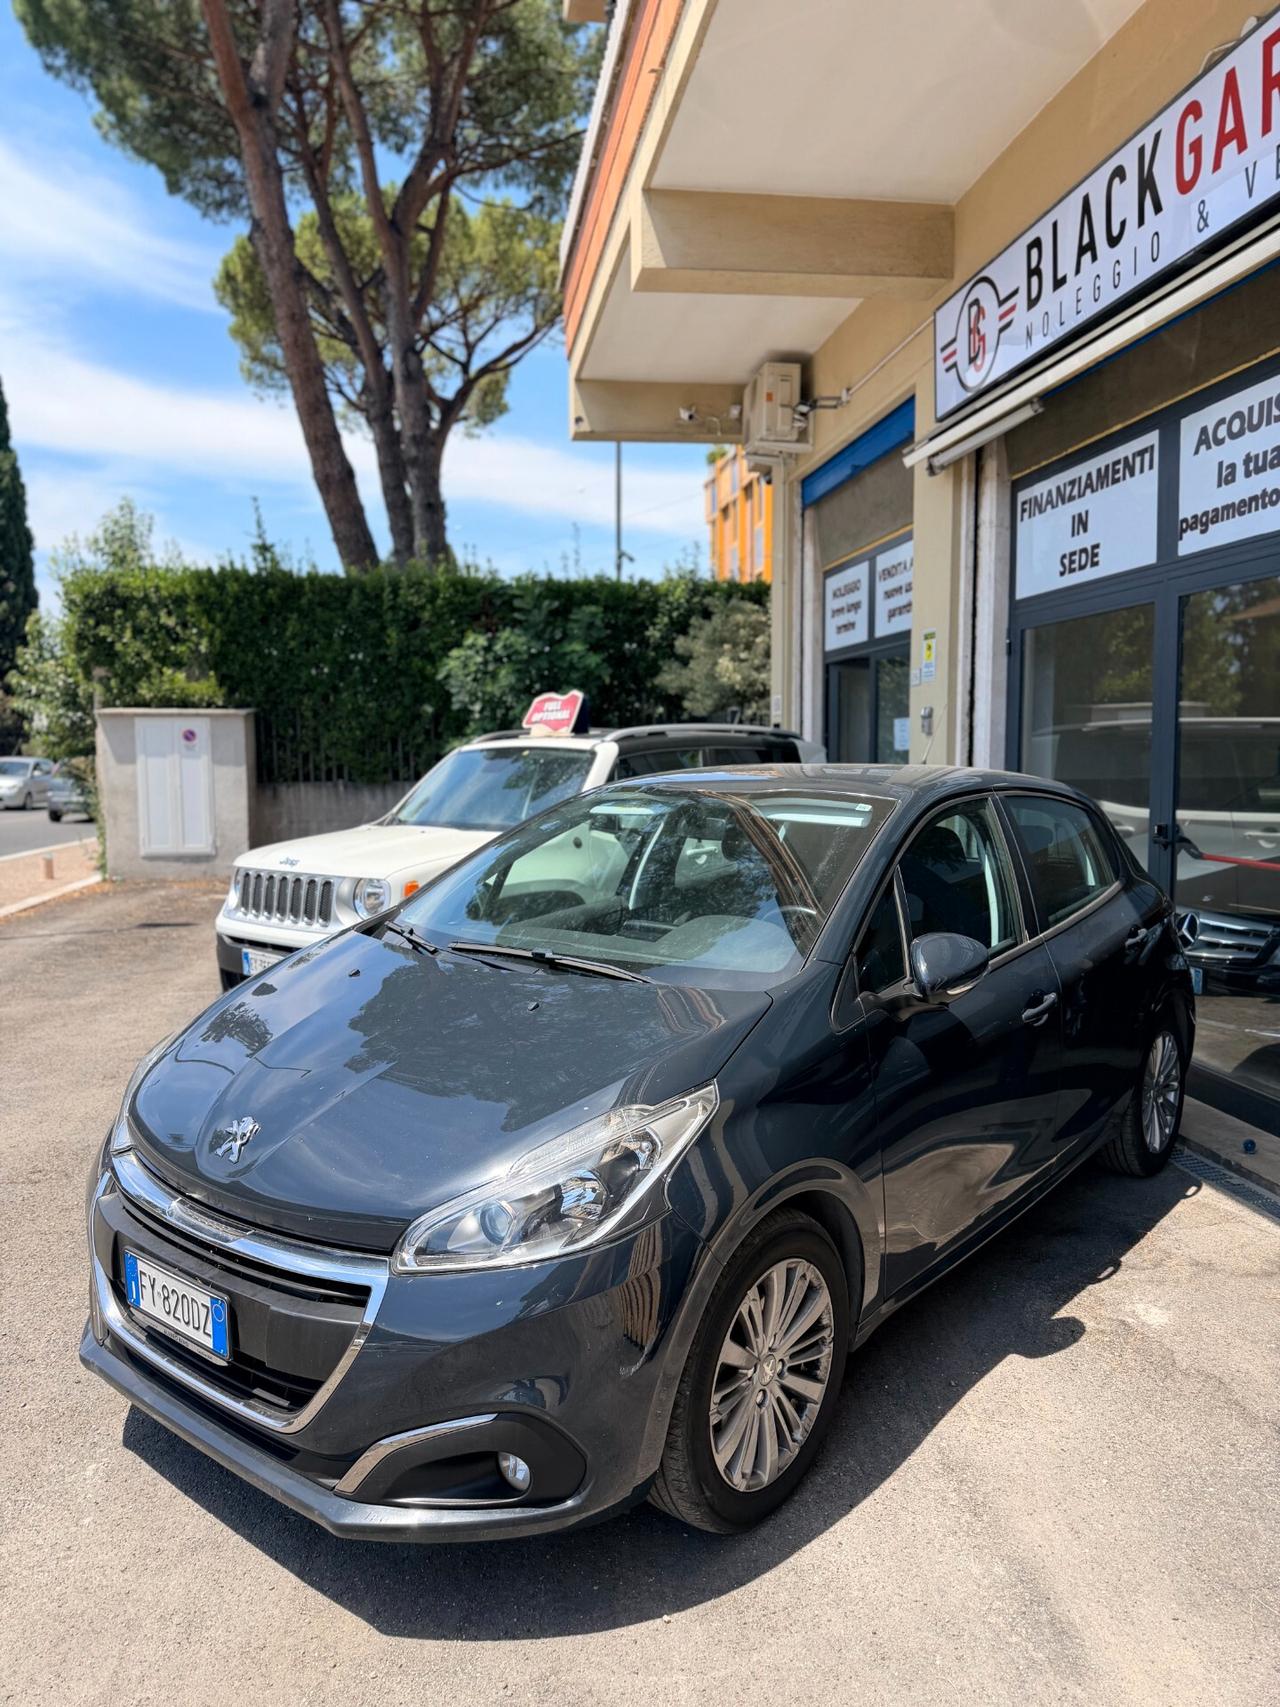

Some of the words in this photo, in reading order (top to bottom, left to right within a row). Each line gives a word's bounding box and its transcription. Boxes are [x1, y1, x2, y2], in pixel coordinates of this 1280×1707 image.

[1026, 231, 1160, 349] NOLEGGIO
[1197, 199, 1210, 233] &
[1019, 444, 1155, 523] FINANZIAMENTI
[1217, 460, 1237, 489] la
[1243, 444, 1280, 479] tua
[1070, 510, 1090, 538] IN
[1178, 487, 1280, 541] pagamento
[1058, 542, 1101, 577] SEDE
